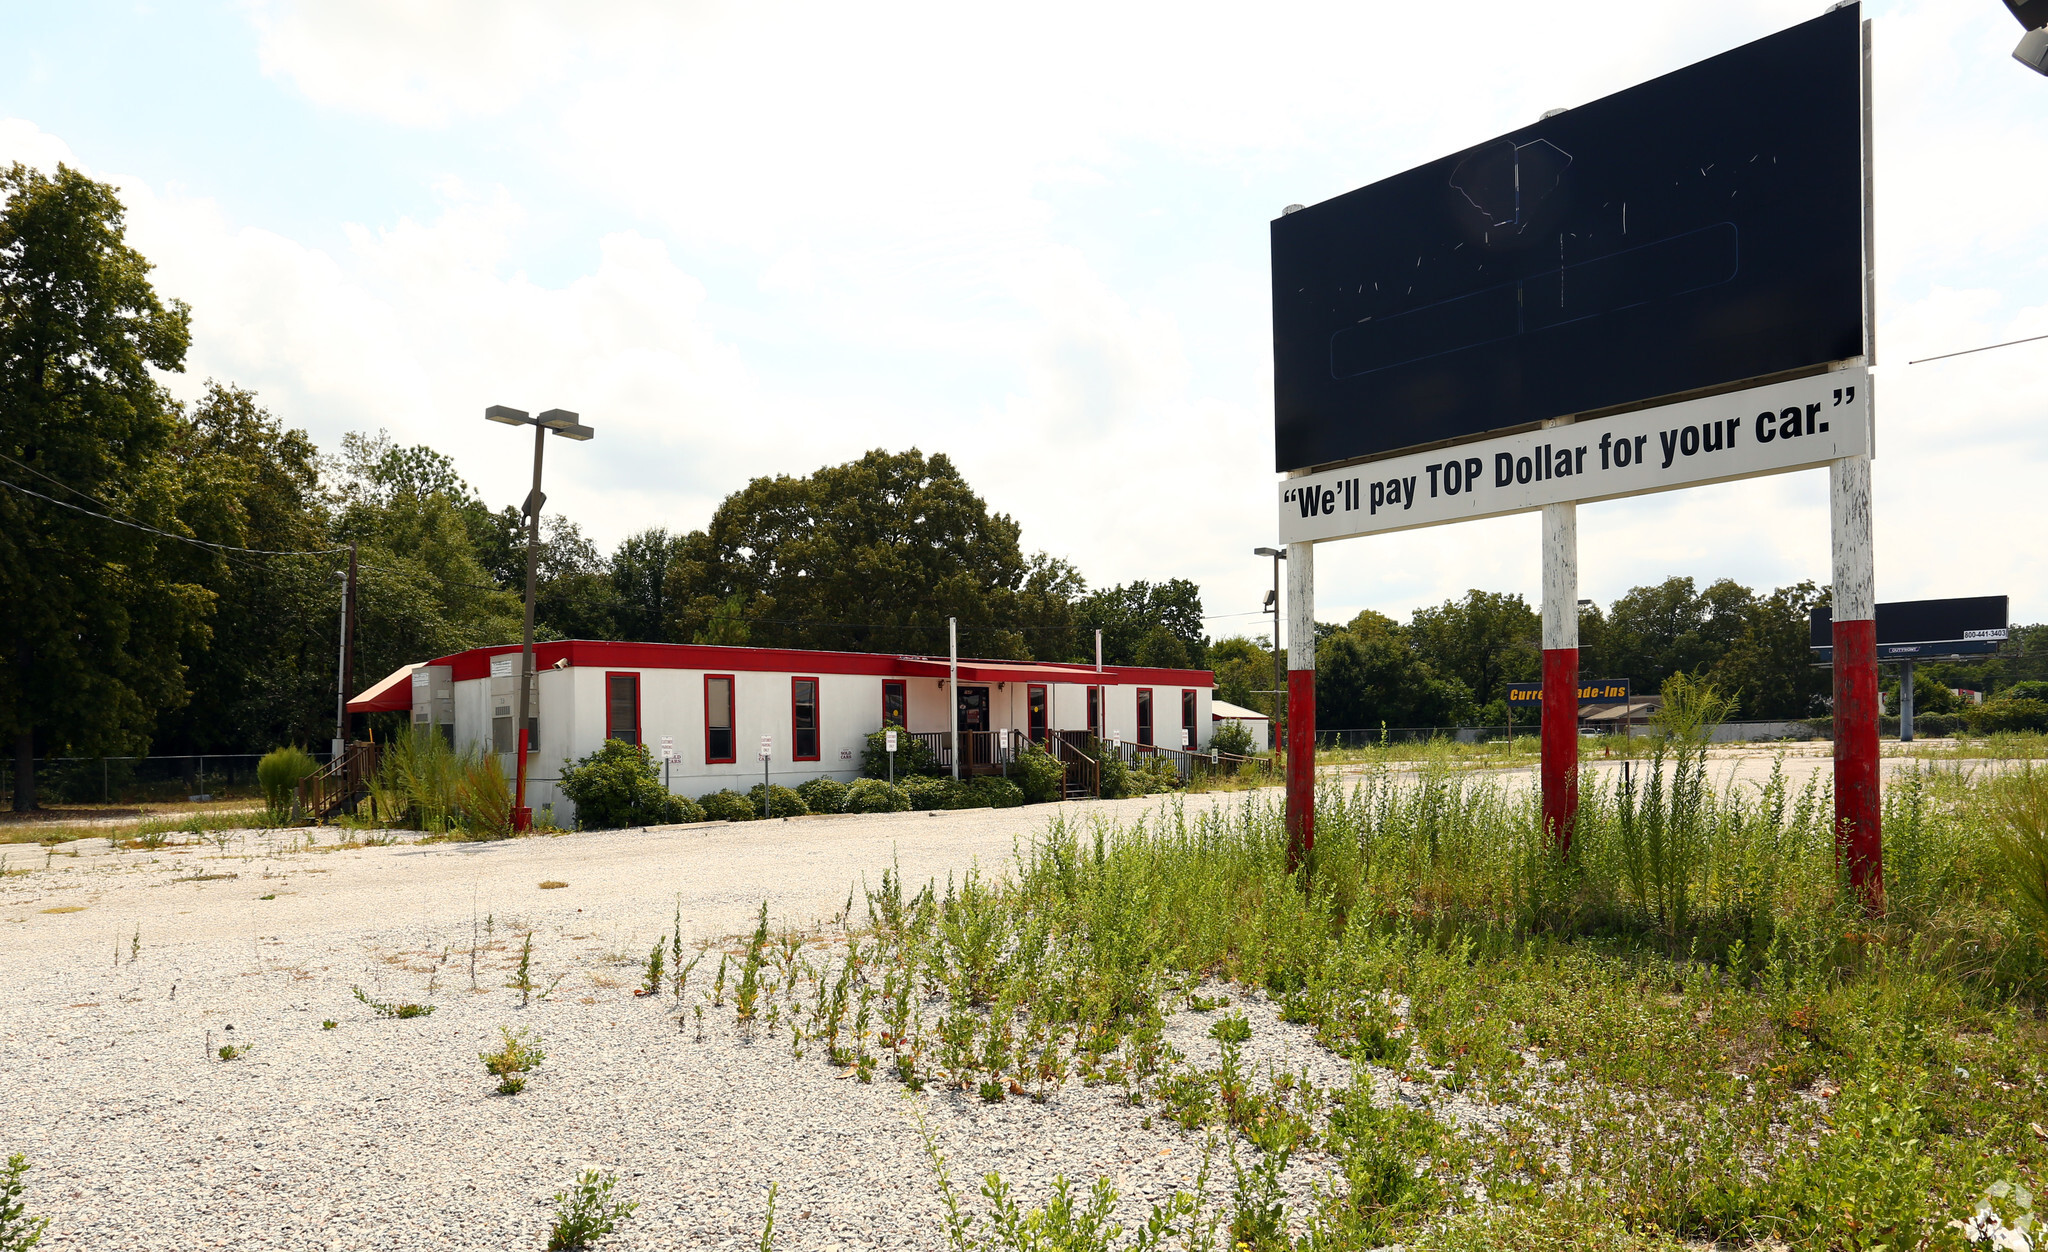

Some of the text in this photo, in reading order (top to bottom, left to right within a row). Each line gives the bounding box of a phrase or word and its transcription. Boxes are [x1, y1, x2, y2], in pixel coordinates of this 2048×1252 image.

[1284, 386, 1856, 518] “We’ll pay TOP Dollar for your car.”
[1964, 630, 2006, 639] 800-441-3403
[1510, 686, 1626, 701] Curre ade-Ins
